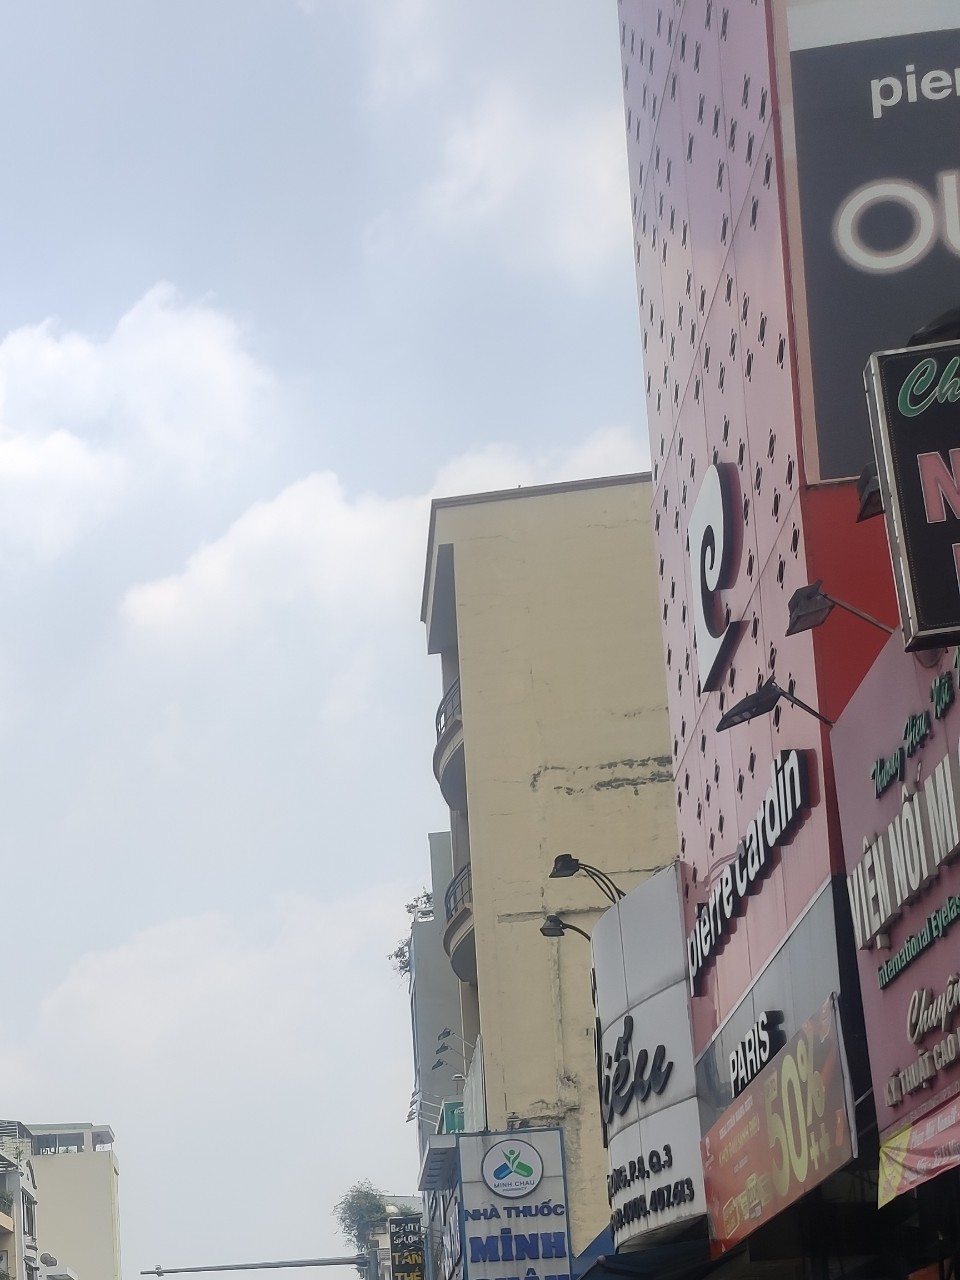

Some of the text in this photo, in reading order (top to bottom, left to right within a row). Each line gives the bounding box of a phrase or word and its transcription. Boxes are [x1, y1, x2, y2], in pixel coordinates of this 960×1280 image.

[687, 748, 804, 997] pierre cardin
[728, 1011, 770, 1099] PARIS
[464, 1199, 565, 1222] NHÀ THUỐC
